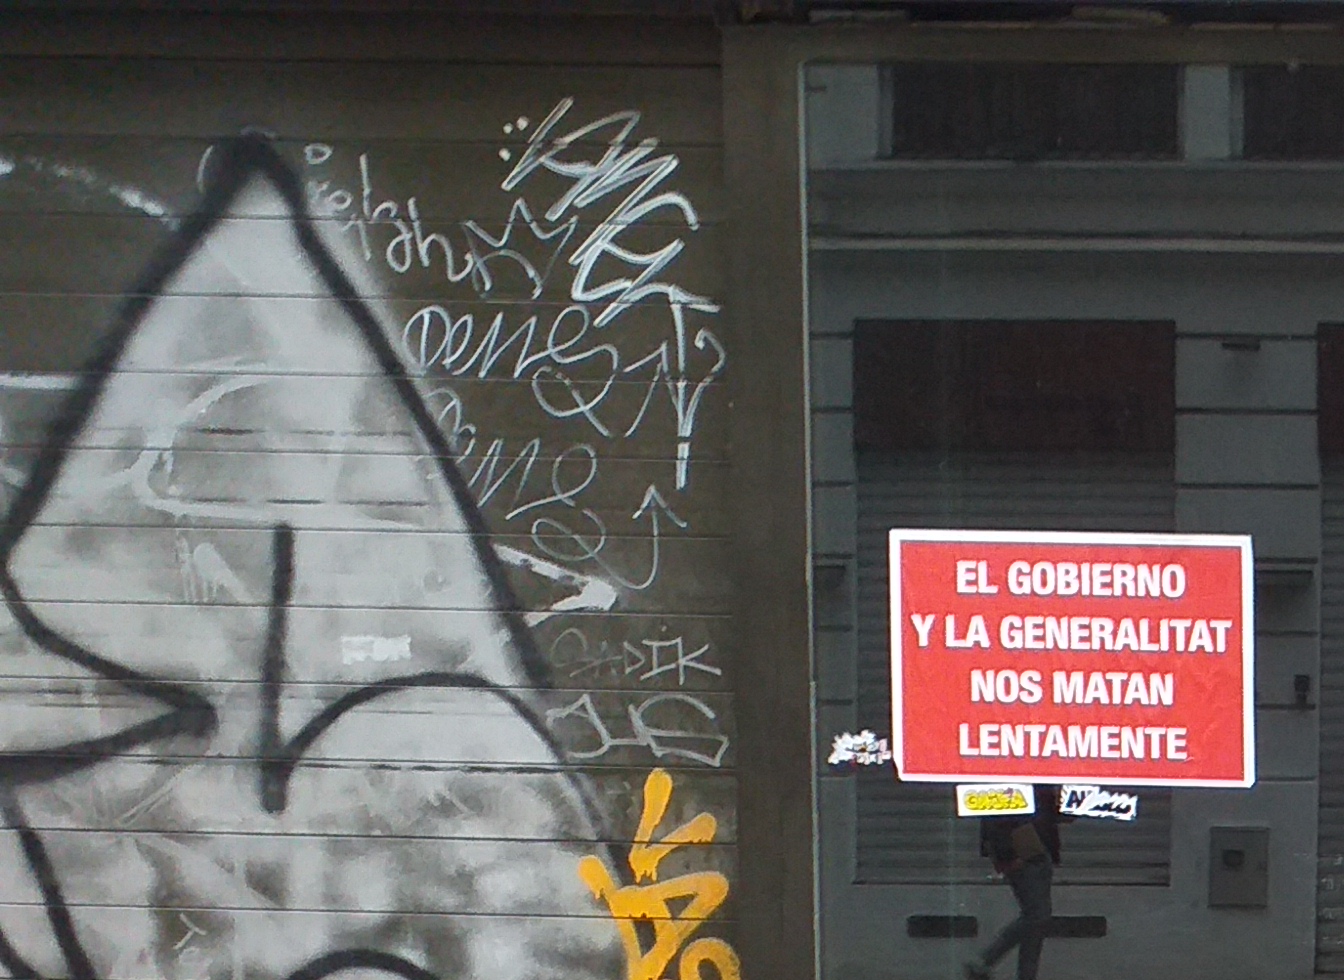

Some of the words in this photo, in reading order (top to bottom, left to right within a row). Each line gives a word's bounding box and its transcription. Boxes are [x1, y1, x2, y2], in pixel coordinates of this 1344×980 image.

[956, 560, 998, 595] EL
[1008, 562, 1186, 599] GOBIERNO
[911, 614, 936, 648] Y
[946, 615, 989, 649] LA
[1000, 616, 1233, 653] GENERALITAT
[971, 670, 1043, 704] NOS
[1053, 671, 1174, 706] MATAN
[959, 722, 1188, 761] LENTAMENTE
